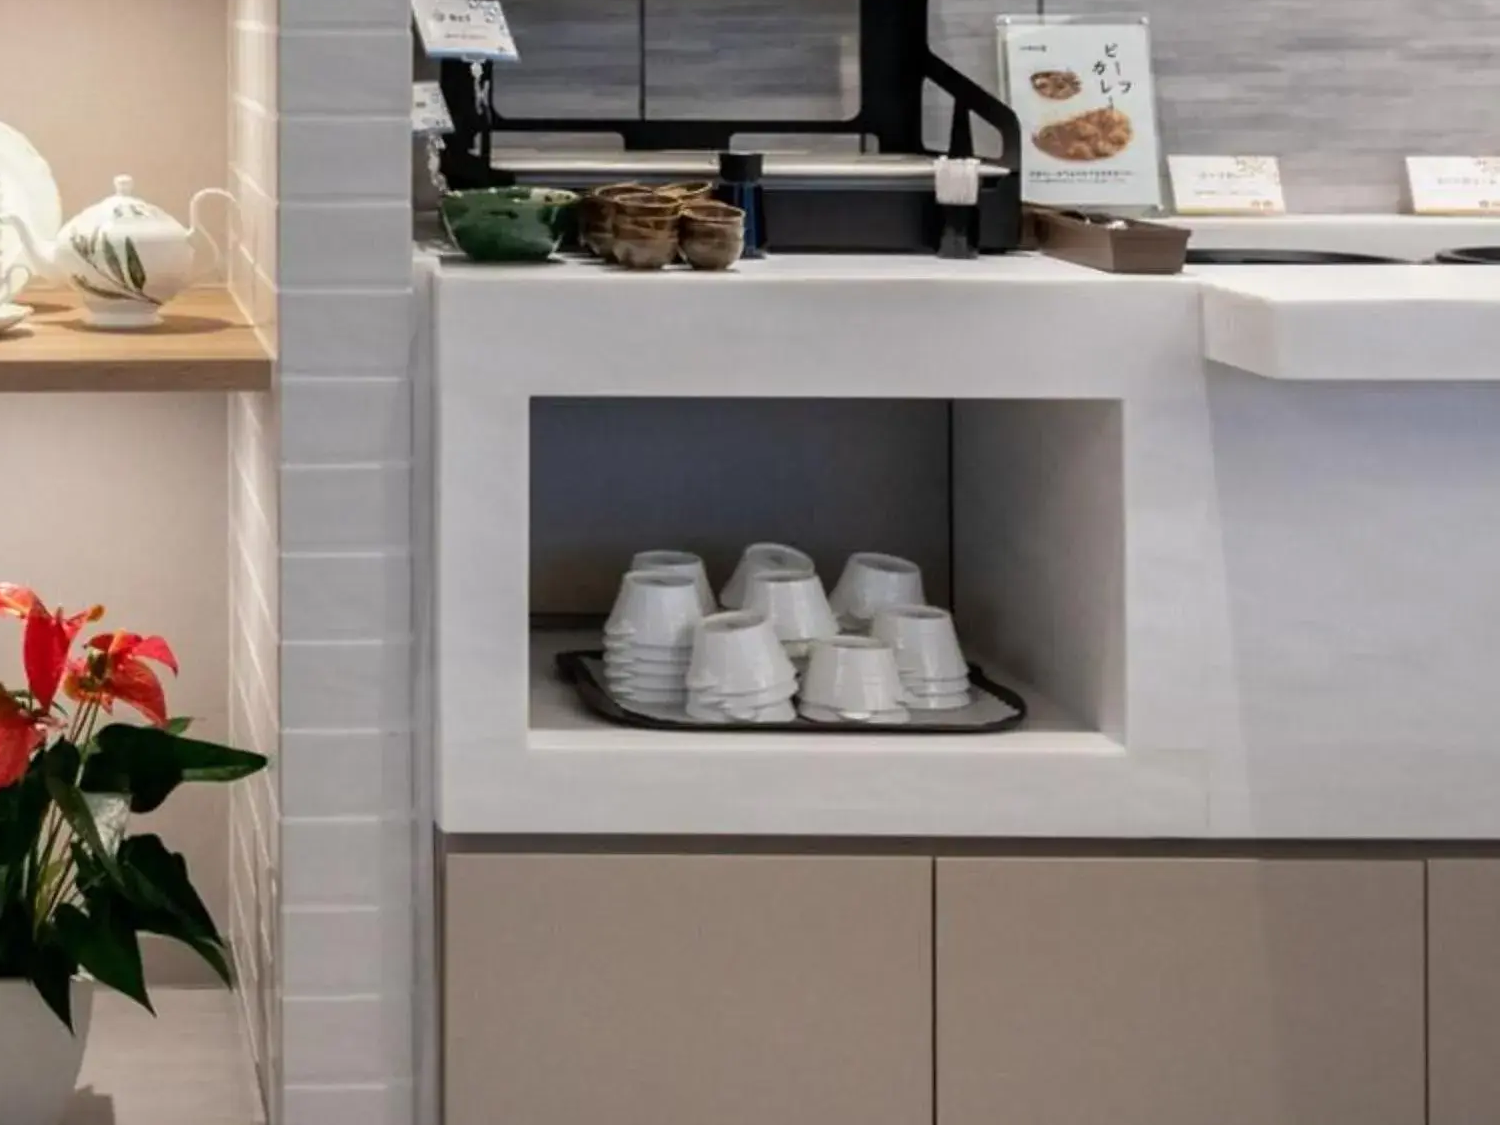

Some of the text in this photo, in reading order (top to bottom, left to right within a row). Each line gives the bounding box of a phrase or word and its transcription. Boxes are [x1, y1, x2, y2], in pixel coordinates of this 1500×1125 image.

[1091, 60, 1115, 111] カレー
[1104, 42, 1132, 93] ビーフ
